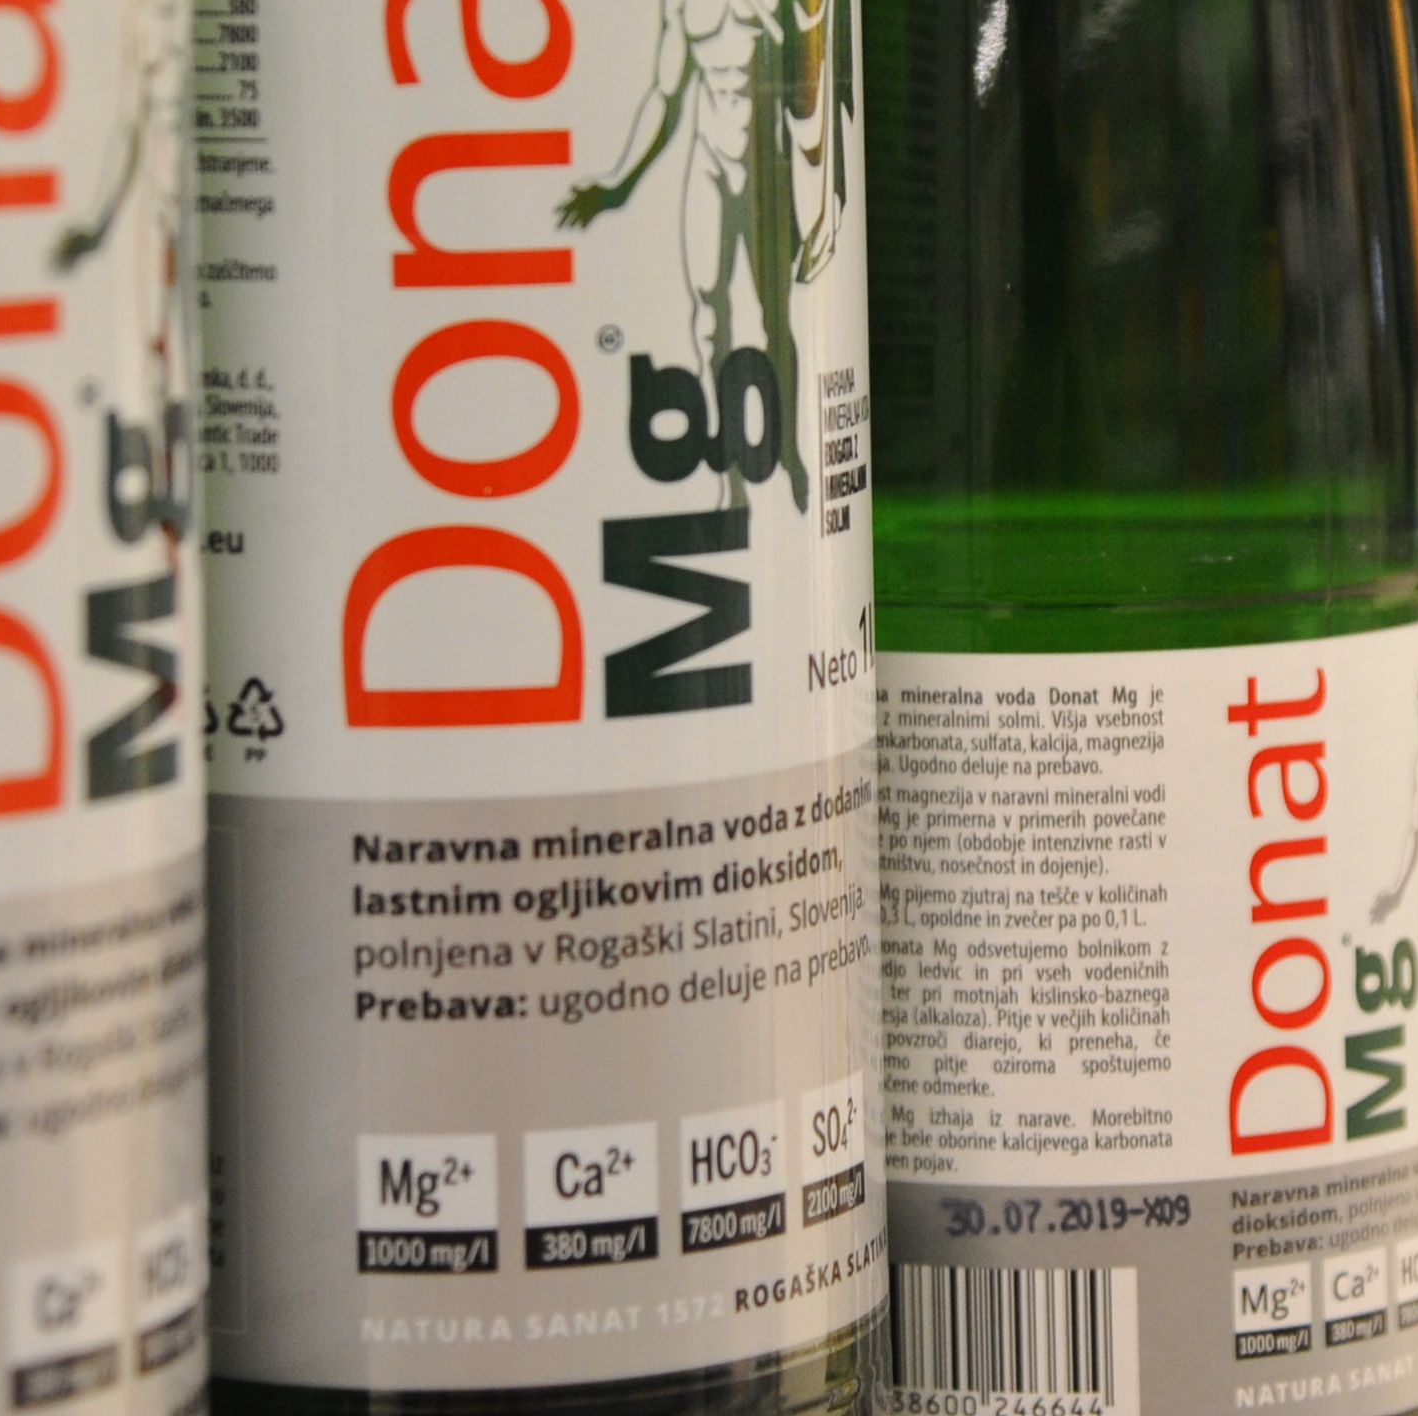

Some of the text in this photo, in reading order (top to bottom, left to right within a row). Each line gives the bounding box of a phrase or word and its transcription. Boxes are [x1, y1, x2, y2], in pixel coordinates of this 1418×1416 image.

[602, 347, 782, 720] Mg
[808, 648, 858, 692] Neto
[902, 686, 983, 705] mineralna
[996, 687, 1035, 705] voda
[1050, 687, 1098, 705] Donat
[1112, 686, 1137, 707] Mg
[1150, 686, 1163, 707] je
[899, 711, 990, 728] mineralnimi
[1052, 709, 1087, 732] Višja
[1096, 709, 1163, 727] vsebnost
[899, 757, 957, 777] Ugodno
[962, 757, 1009, 778] deluje
[1014, 761, 1031, 774] na
[1037, 755, 1102, 779] prebavo.
[897, 787, 973, 808] magnezija
[979, 791, 986, 803] v
[992, 786, 1048, 805] naravni
[1055, 785, 1129, 805] mineralni
[1133, 784, 1165, 802] vodi
[907, 808, 919, 830] je
[927, 813, 995, 831] primerna
[1003, 814, 1011, 827] v
[1019, 810, 1086, 831] primerih
[1094, 809, 1165, 831] povečane
[352, 833, 520, 865] Naravna
[533, 818, 713, 861] mineralna
[723, 806, 788, 842] voda
[794, 807, 805, 828] z
[1159, 836, 1166, 848] v
[940, 855, 1016, 874] nosečnost
[1021, 856, 1032, 874] in
[352, 847, 843, 922] lastnim ogljikovim dioksidom,
[906, 887, 956, 908] pijemo
[961, 887, 1010, 908] zjutraj
[1016, 891, 1033, 904] na
[1041, 885, 1079, 904] tešče
[1085, 890, 1093, 903] v
[1099, 884, 1167, 906] količinah
[921, 908, 981, 930] opoldne
[987, 910, 1000, 928] in
[1005, 908, 1053, 929] zvečer
[1059, 913, 1077, 932] pa
[1082, 913, 1101, 931] po
[1228, 667, 1334, 1156] Donat
[355, 938, 513, 978] polnjena
[525, 942, 543, 966] v
[556, 924, 683, 972] Rogaški
[693, 908, 783, 952] Slatini,
[934, 938, 1151, 964] Mg odsvetujemo bolnikom
[919, 961, 961, 980] ledvic
[975, 962, 989, 980] in
[1003, 963, 1022, 985] pri
[1036, 962, 1071, 982] vseh
[1085, 960, 1168, 981] vodeničnih
[356, 991, 528, 1021] Prebava:
[540, 980, 670, 1025] ugodno
[680, 966, 766, 1003] deluje
[775, 959, 802, 986] na
[997, 1008, 1031, 1031] Pitje
[1037, 1013, 1045, 1027] v
[1051, 1007, 1095, 1031] večjih
[1101, 1006, 1170, 1026] količinah
[935, 1055, 968, 1077] pitje
[993, 1057, 1056, 1074] oziroma
[1082, 1054, 1171, 1077] spoštujemo
[891, 1107, 1172, 1130] Mg izhaja iz narave. Morebitno
[902, 1130, 933, 1147] bele
[939, 1132, 996, 1150] oborine
[1002, 1131, 1088, 1155] kalcijevega
[1095, 1130, 1172, 1150] karbonata
[807, 1171, 862, 1218] 2100 mg/l
[1232, 1183, 1320, 1209] Naravna
[688, 1201, 781, 1246] 7800 mg/l
[1232, 1206, 1343, 1234] dioksidom,
[366, 1237, 489, 1272] 1000 mg/l
[542, 1224, 646, 1263] 380 mg/l
[1232, 1234, 1324, 1260] Prebava:
[361, 1260, 842, 1343] NATURA SANAT 1572 ROGAŠKA
[892, 1390, 1105, 1416] 38600 246644
[1236, 1375, 1342, 1408] NATURA
